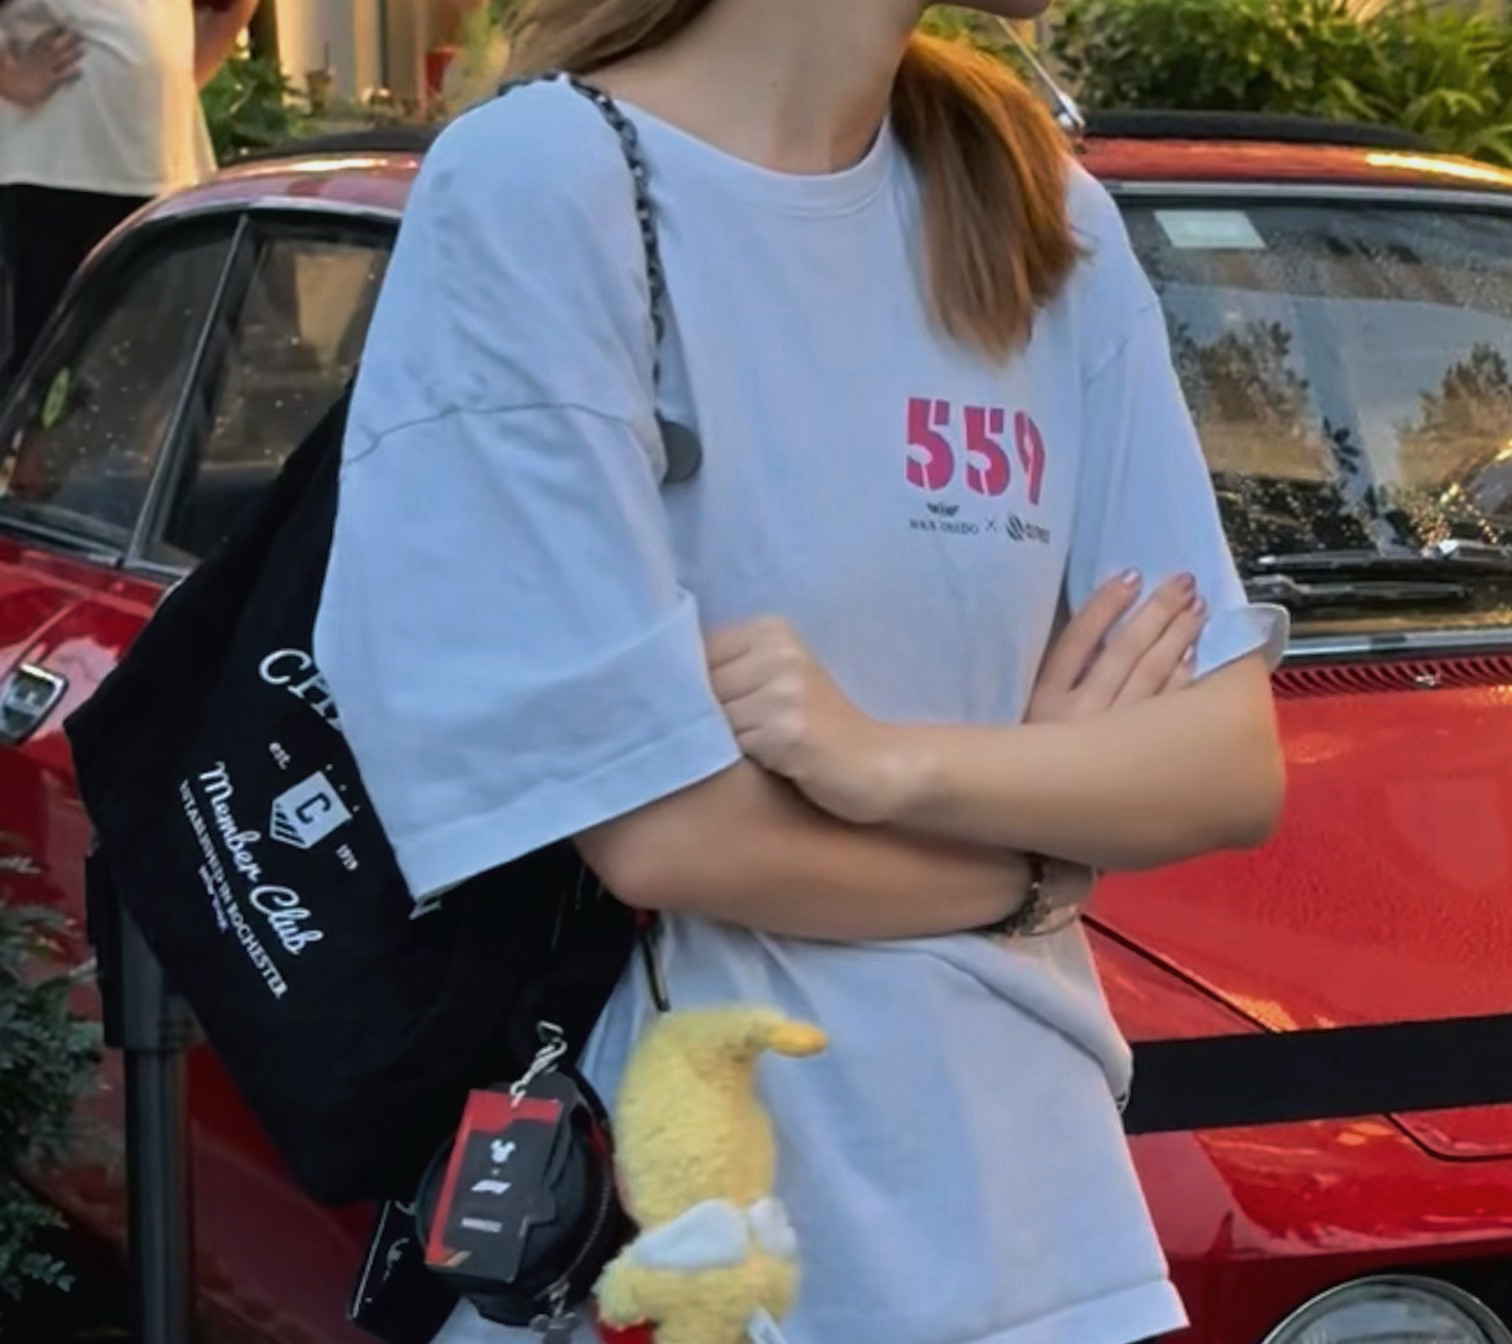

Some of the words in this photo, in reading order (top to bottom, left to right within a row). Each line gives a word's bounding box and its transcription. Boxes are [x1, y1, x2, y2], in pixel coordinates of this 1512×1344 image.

[905, 396, 1046, 506] 559
[199, 761, 263, 883] Member
[249, 884, 326, 956] Club
